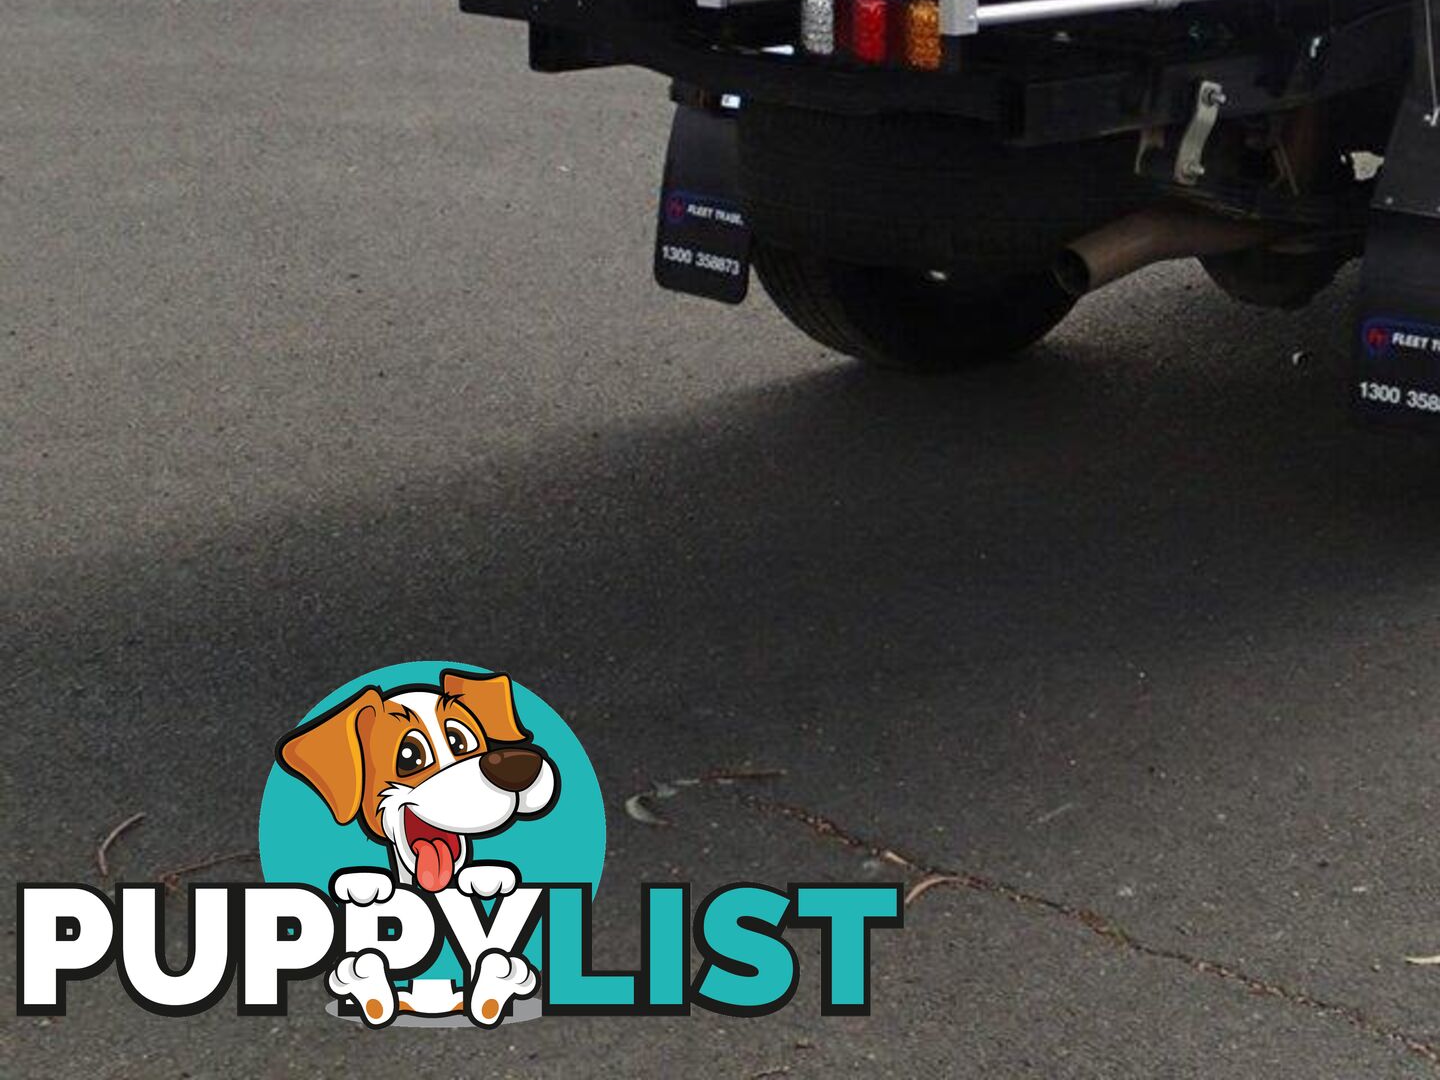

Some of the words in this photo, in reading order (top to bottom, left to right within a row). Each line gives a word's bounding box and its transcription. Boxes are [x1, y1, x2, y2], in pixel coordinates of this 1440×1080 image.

[662, 245, 692, 264] 1300
[695, 252, 740, 276] 358873
[1392, 332, 1429, 349] FLEET
[1359, 381, 1400, 404] 1300
